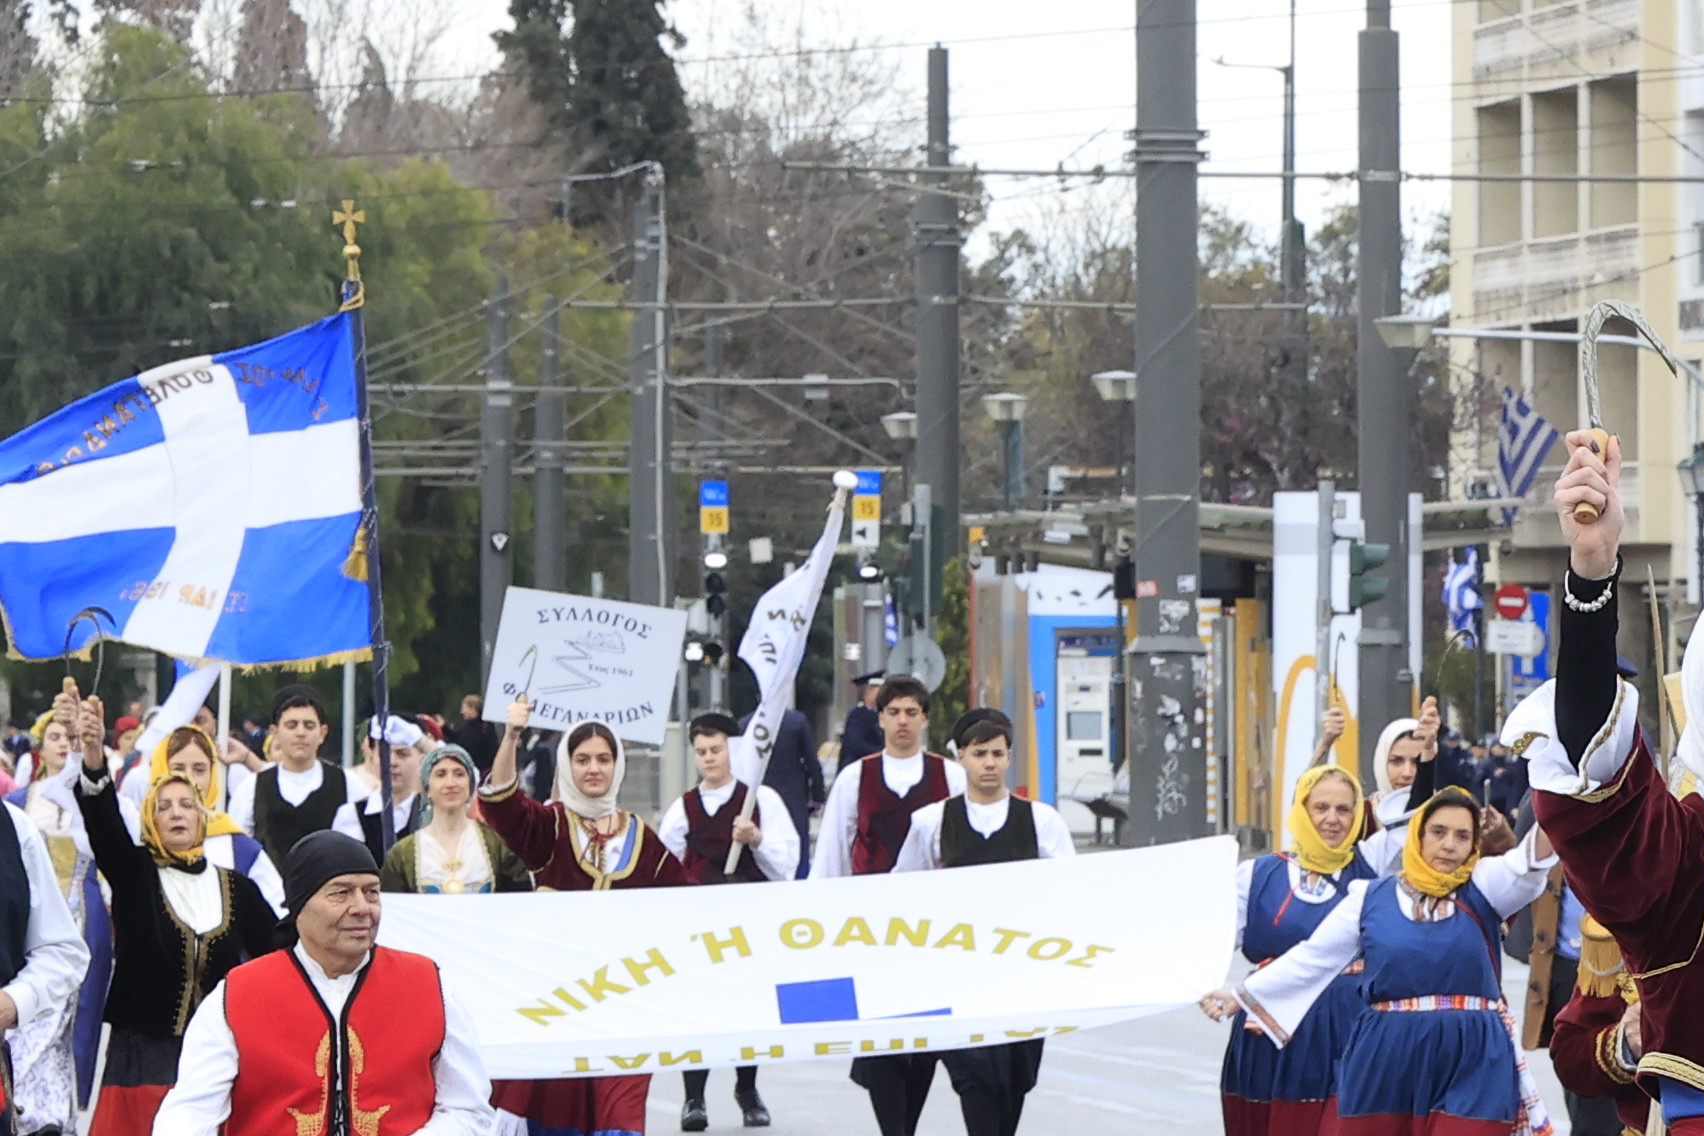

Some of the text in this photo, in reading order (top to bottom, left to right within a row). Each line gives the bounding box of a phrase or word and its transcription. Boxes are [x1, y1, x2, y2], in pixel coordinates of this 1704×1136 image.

[537, 607, 653, 640] ΣΥΛΛΟΓΟΣ
[514, 946, 677, 1027] ΝΙΚΗ
[778, 916, 1117, 969] ΘΑΝΑΤΟΣ
